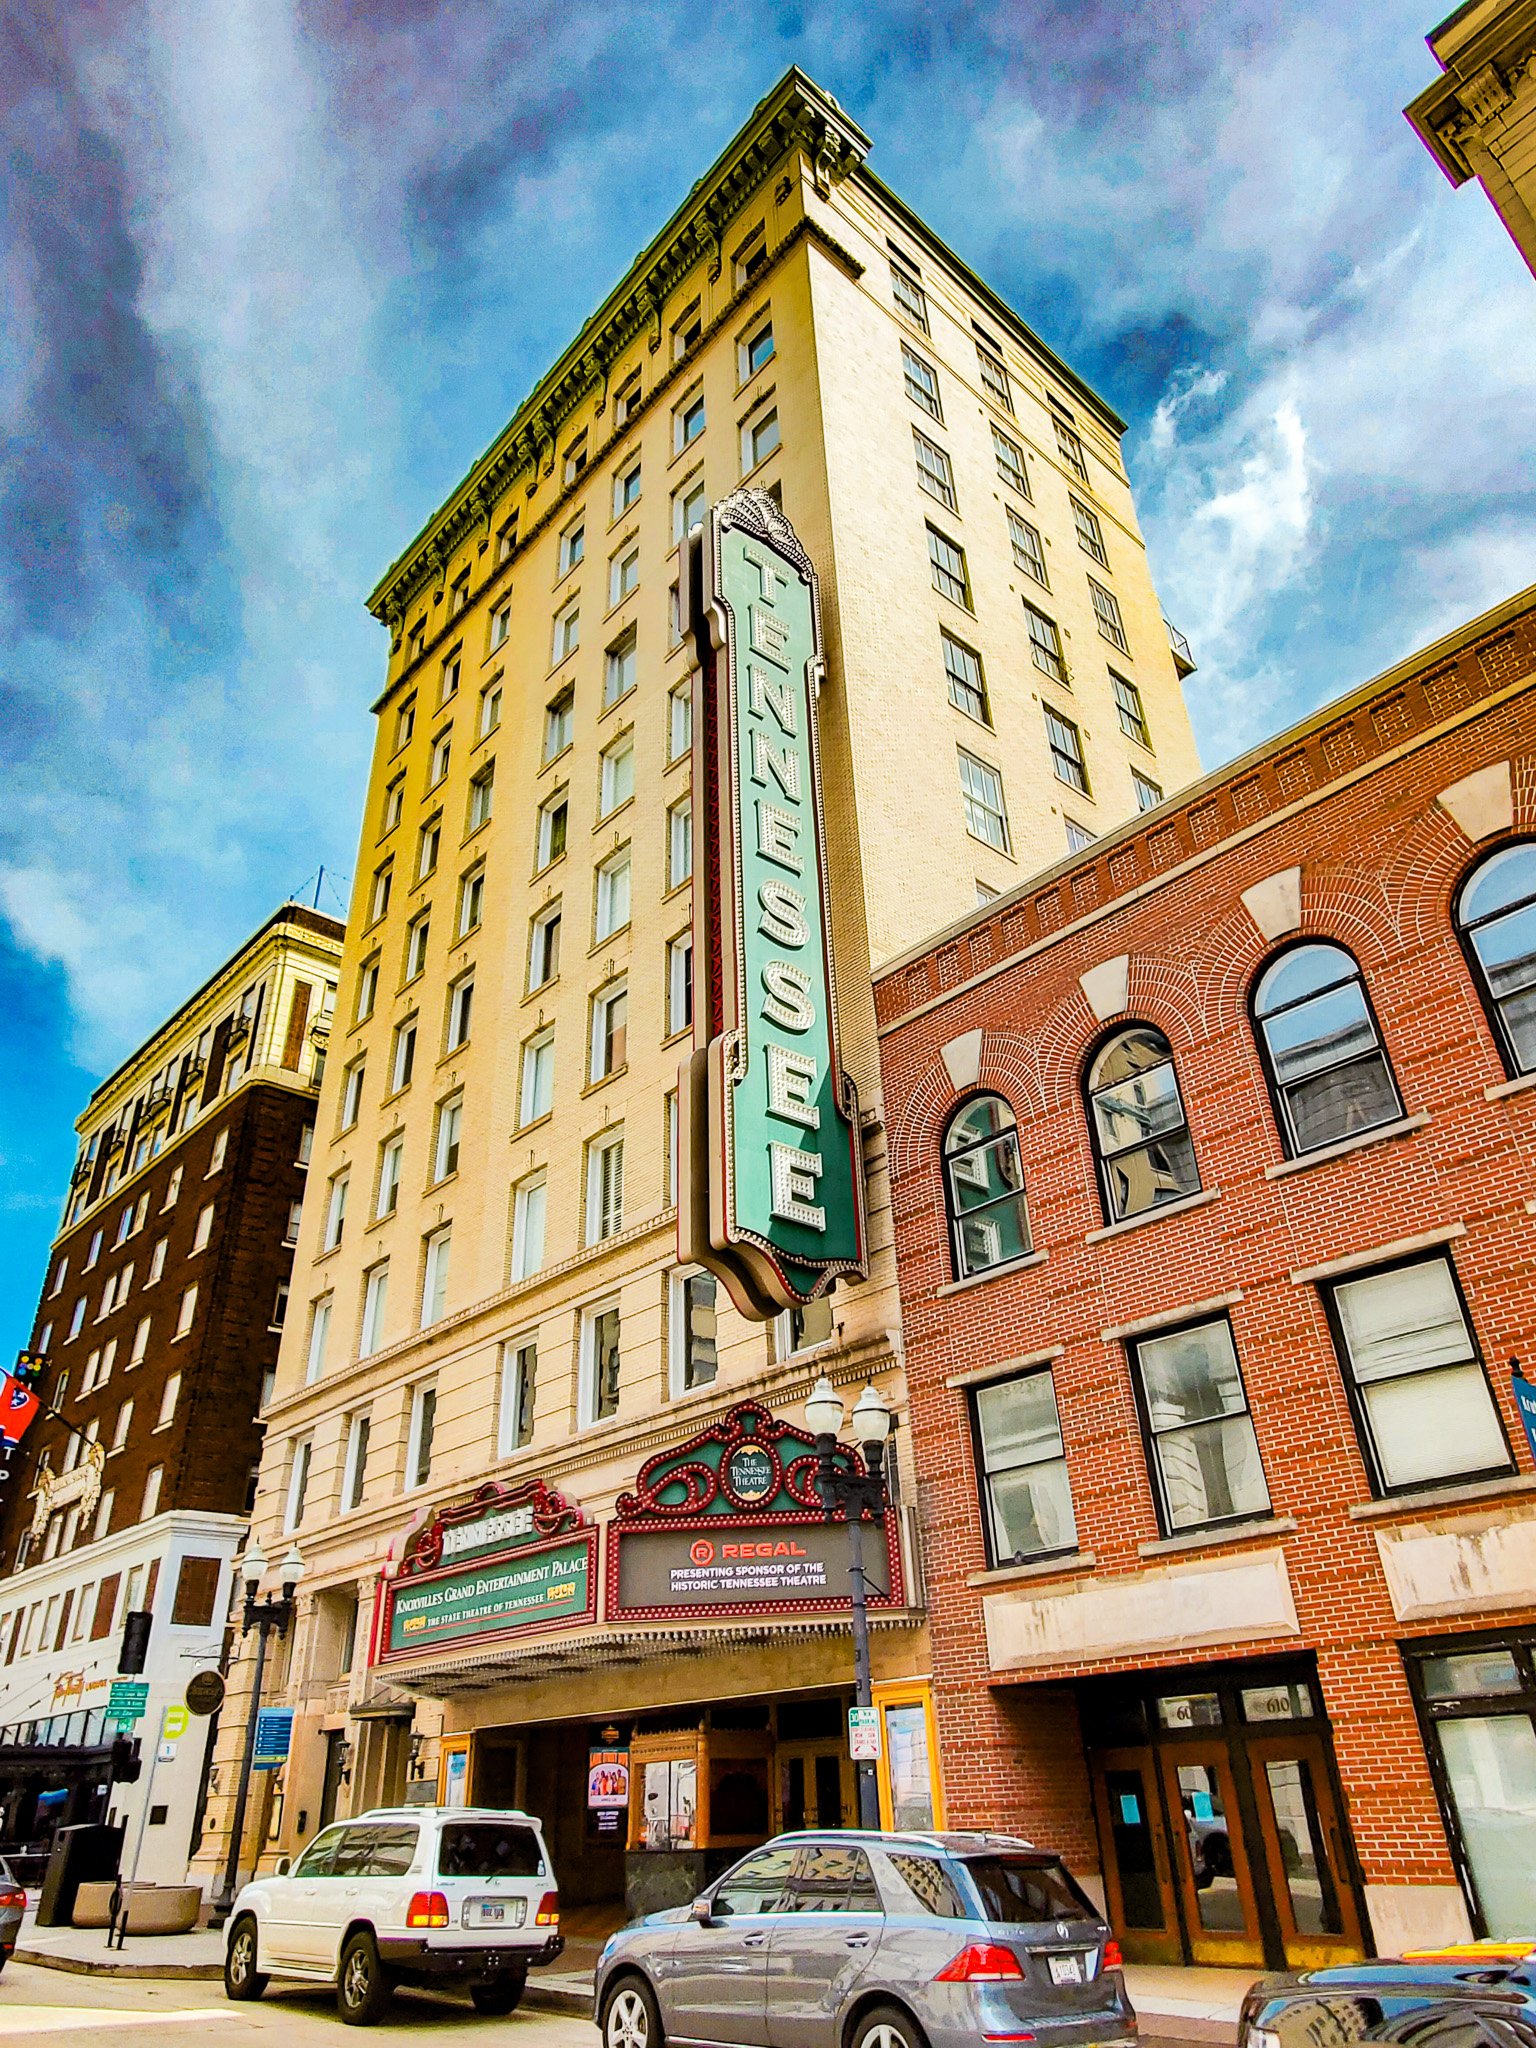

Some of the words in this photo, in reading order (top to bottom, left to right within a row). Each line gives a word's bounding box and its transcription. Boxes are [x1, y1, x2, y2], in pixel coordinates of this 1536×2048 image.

[743, 546, 826, 1232] TENNESSEE
[742, 1457, 757, 1466] THE
[730, 1466, 771, 1476] TENNESSEE
[733, 1476, 767, 1486] THEATRE
[442, 1506, 533, 1556] TENNESSEE
[722, 1541, 806, 1559] REGAL
[444, 1585, 475, 1602] GRAND
[476, 1566, 550, 1596] ENTERTAINMENT
[552, 1556, 588, 1577] PALACE
[670, 1567, 734, 1579] PRESENTING
[736, 1564, 784, 1577] SPONSOR
[785, 1564, 801, 1574] OF
[803, 1562, 824, 1573] THE
[670, 1579, 718, 1592] HISTORIC
[719, 1577, 778, 1589] TENNESSEE
[780, 1574, 827, 1586] THEATRE
[427, 1617, 440, 1627] THE
[441, 1612, 461, 1624] STATE
[462, 1604, 492, 1620] THEATRE
[494, 1602, 503, 1613] OF
[504, 1593, 545, 1611] TENNESSEE
[1267, 1697, 1290, 1713] 610
